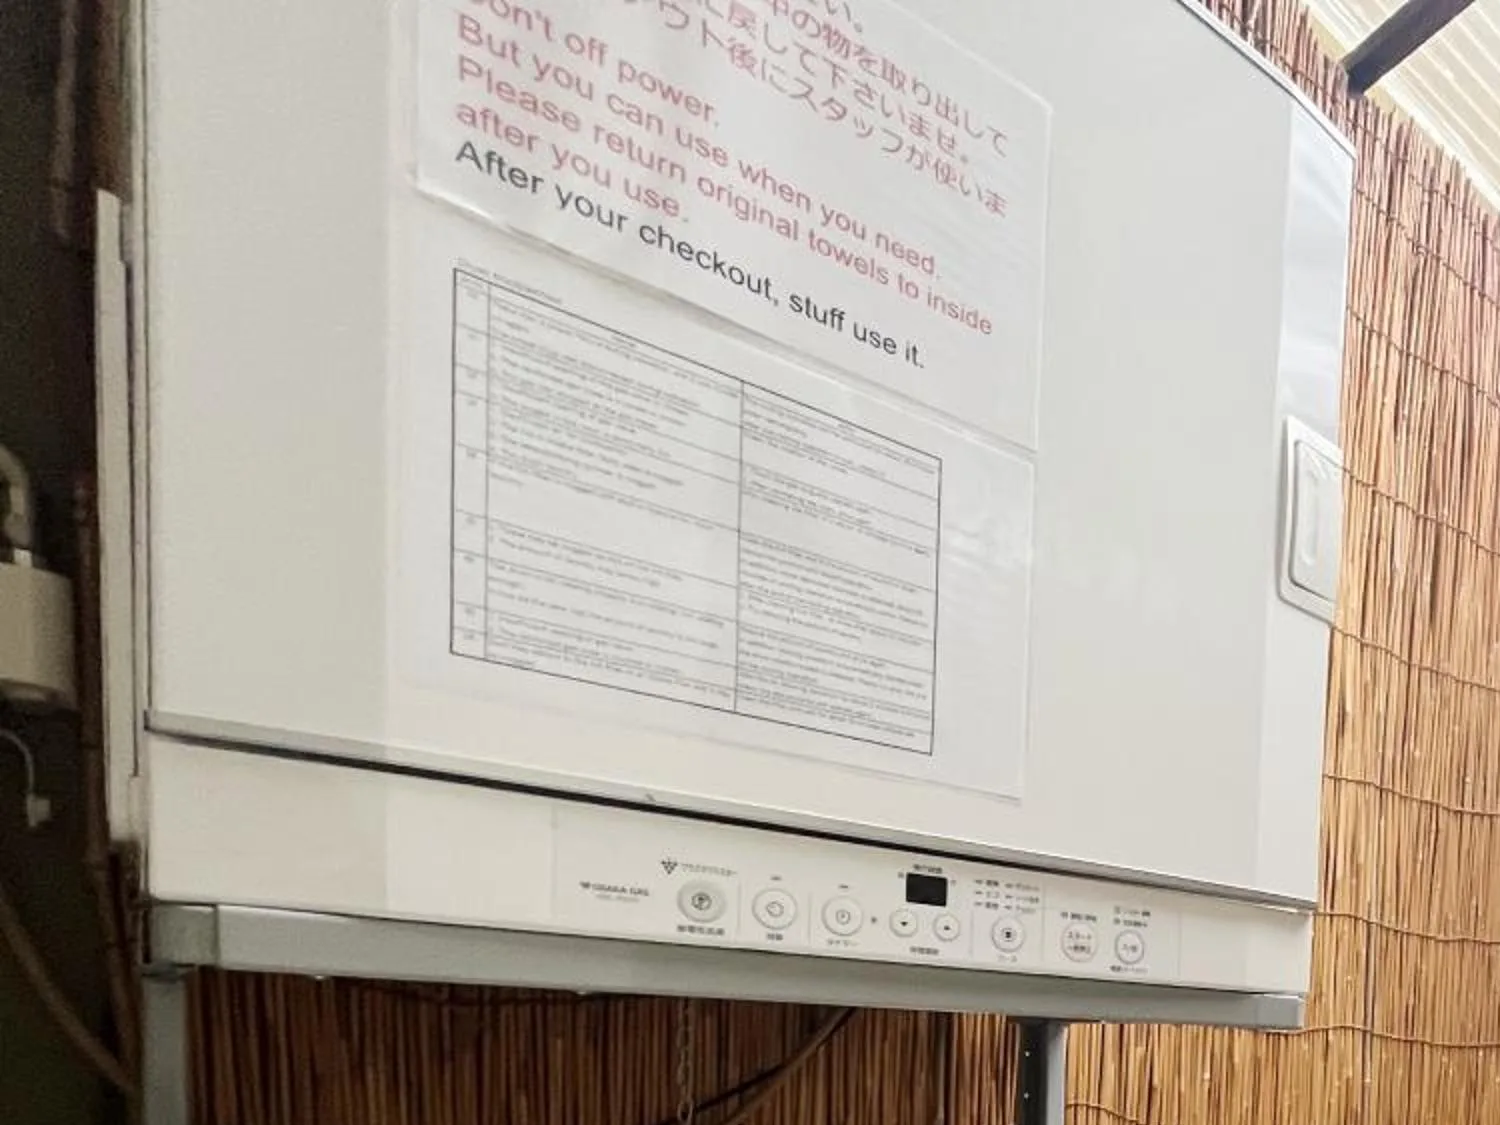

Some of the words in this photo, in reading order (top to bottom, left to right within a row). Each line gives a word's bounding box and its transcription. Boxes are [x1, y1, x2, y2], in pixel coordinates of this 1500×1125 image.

[455, 103, 541, 153] after
[551, 143, 612, 190] you
[623, 177, 689, 223] use.
[459, 13, 521, 69] But
[532, 53, 594, 102] you
[606, 92, 664, 136] can
[675, 126, 730, 168] use
[738, 159, 812, 212] when
[820, 203, 867, 242] you
[875, 231, 942, 280] need.
[472, 0, 554, 42] on't
[564, 33, 608, 66] off
[617, 60, 720, 128] power.
[624, 0, 1008, 217] ウト後にスタッフが使いま
[455, 140, 545, 195] After
[554, 183, 629, 233] your
[639, 224, 779, 306] checkout,
[788, 291, 846, 333] stuff
[852, 321, 898, 355] use
[904, 340, 925, 369] it.
[458, 54, 582, 132] Please
[593, 124, 687, 184] return
[697, 175, 799, 241] original
[808, 228, 890, 286] towels
[898, 273, 920, 300] to
[926, 285, 994, 335] inside
